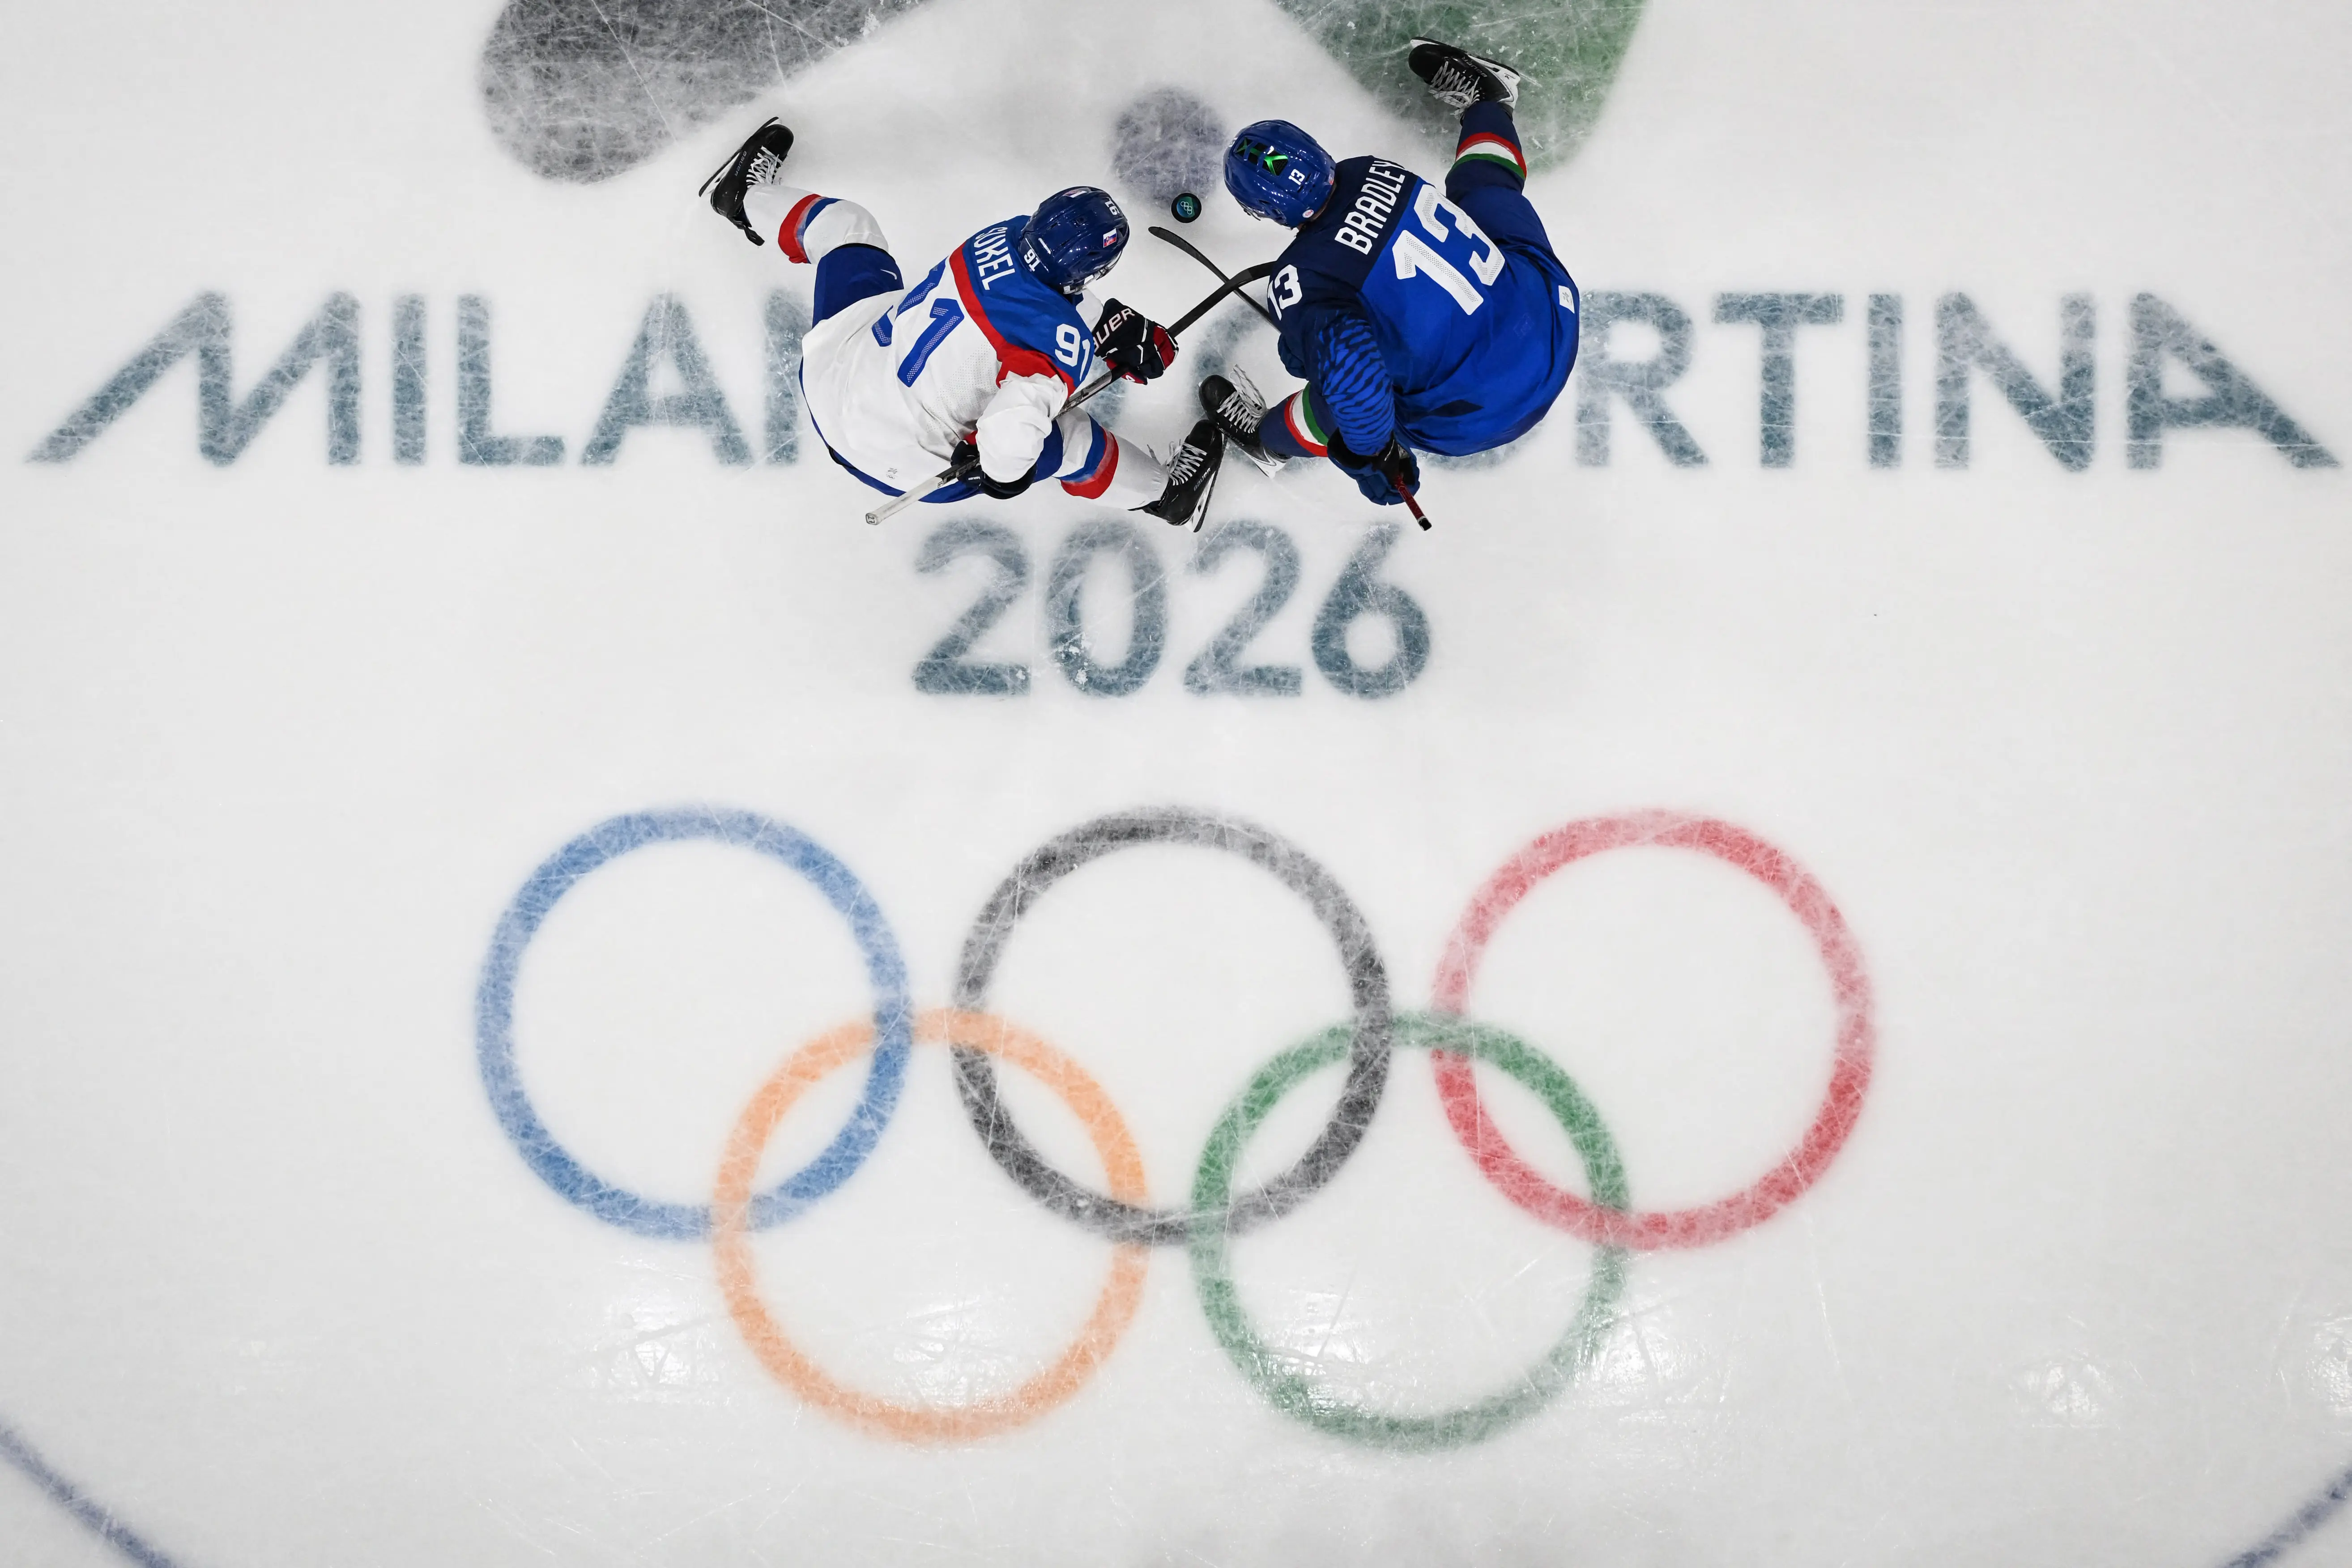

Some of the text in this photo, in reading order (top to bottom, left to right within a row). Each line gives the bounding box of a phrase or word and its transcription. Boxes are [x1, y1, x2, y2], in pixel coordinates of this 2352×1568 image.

[1288, 169, 1305, 185] 13
[1334, 161, 1405, 255] BRADLEY
[974, 227, 1015, 290] SUKEL
[1024, 249, 1040, 272] 91
[1392, 184, 1505, 315] 13
[1267, 264, 1303, 321] 13
[1055, 324, 1091, 381] 91
[912, 518, 1432, 699] 2026
